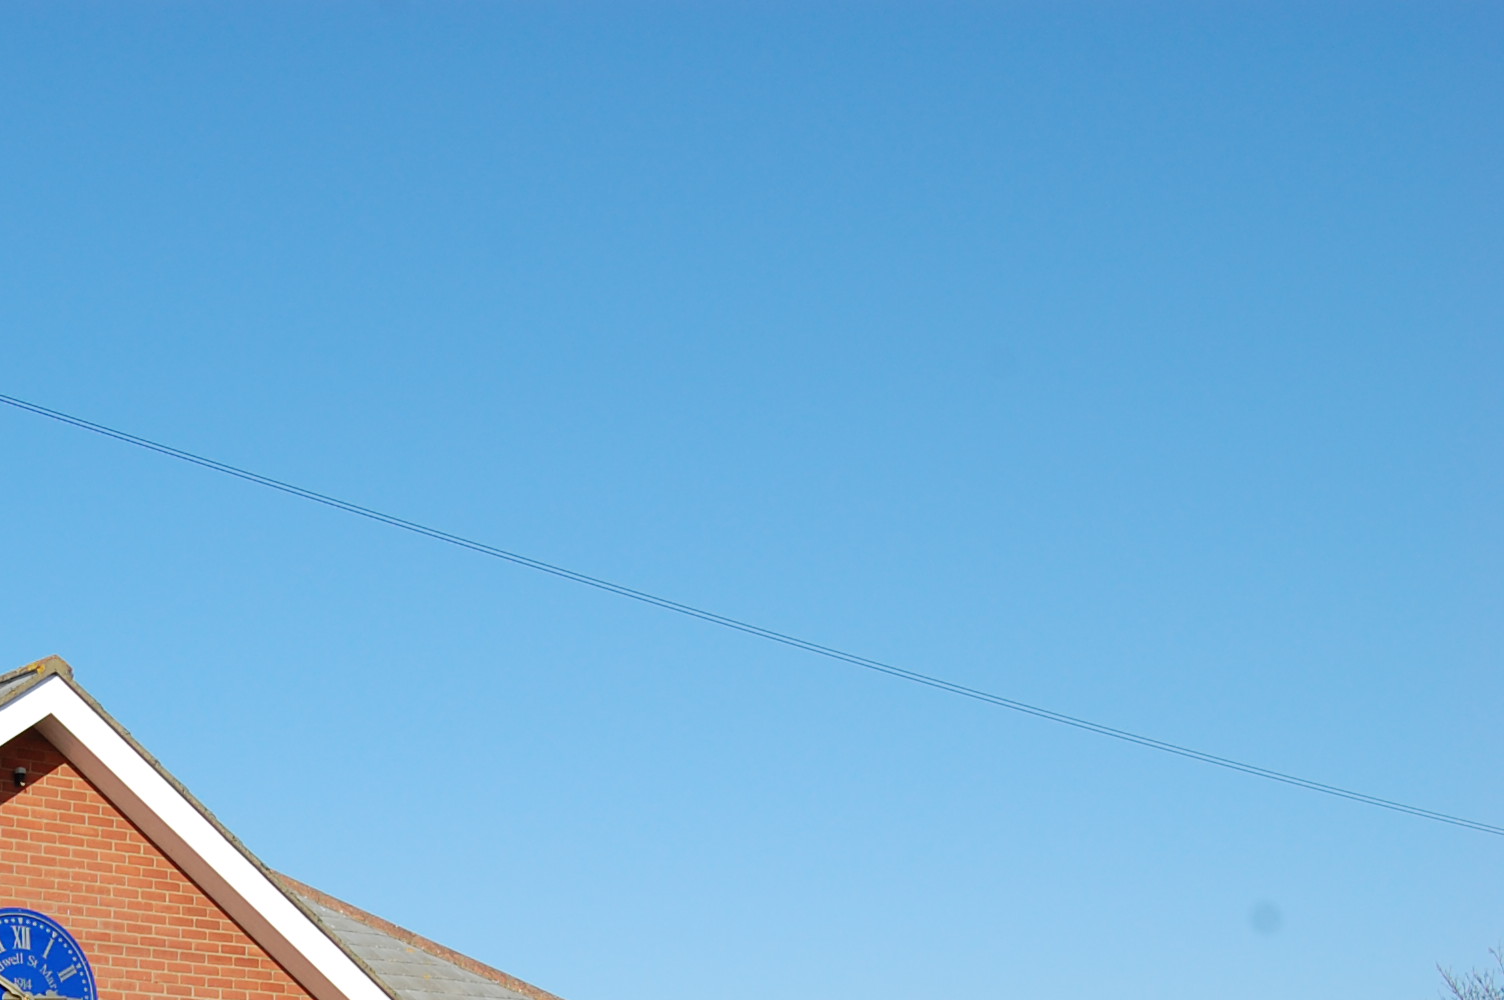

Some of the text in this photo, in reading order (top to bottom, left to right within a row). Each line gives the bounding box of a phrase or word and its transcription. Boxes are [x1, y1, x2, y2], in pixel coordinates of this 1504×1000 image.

[12, 925, 31, 951] XII
[27, 954, 38, 968] St
[58, 964, 78, 982] II
[13, 977, 32, 990] 1914
